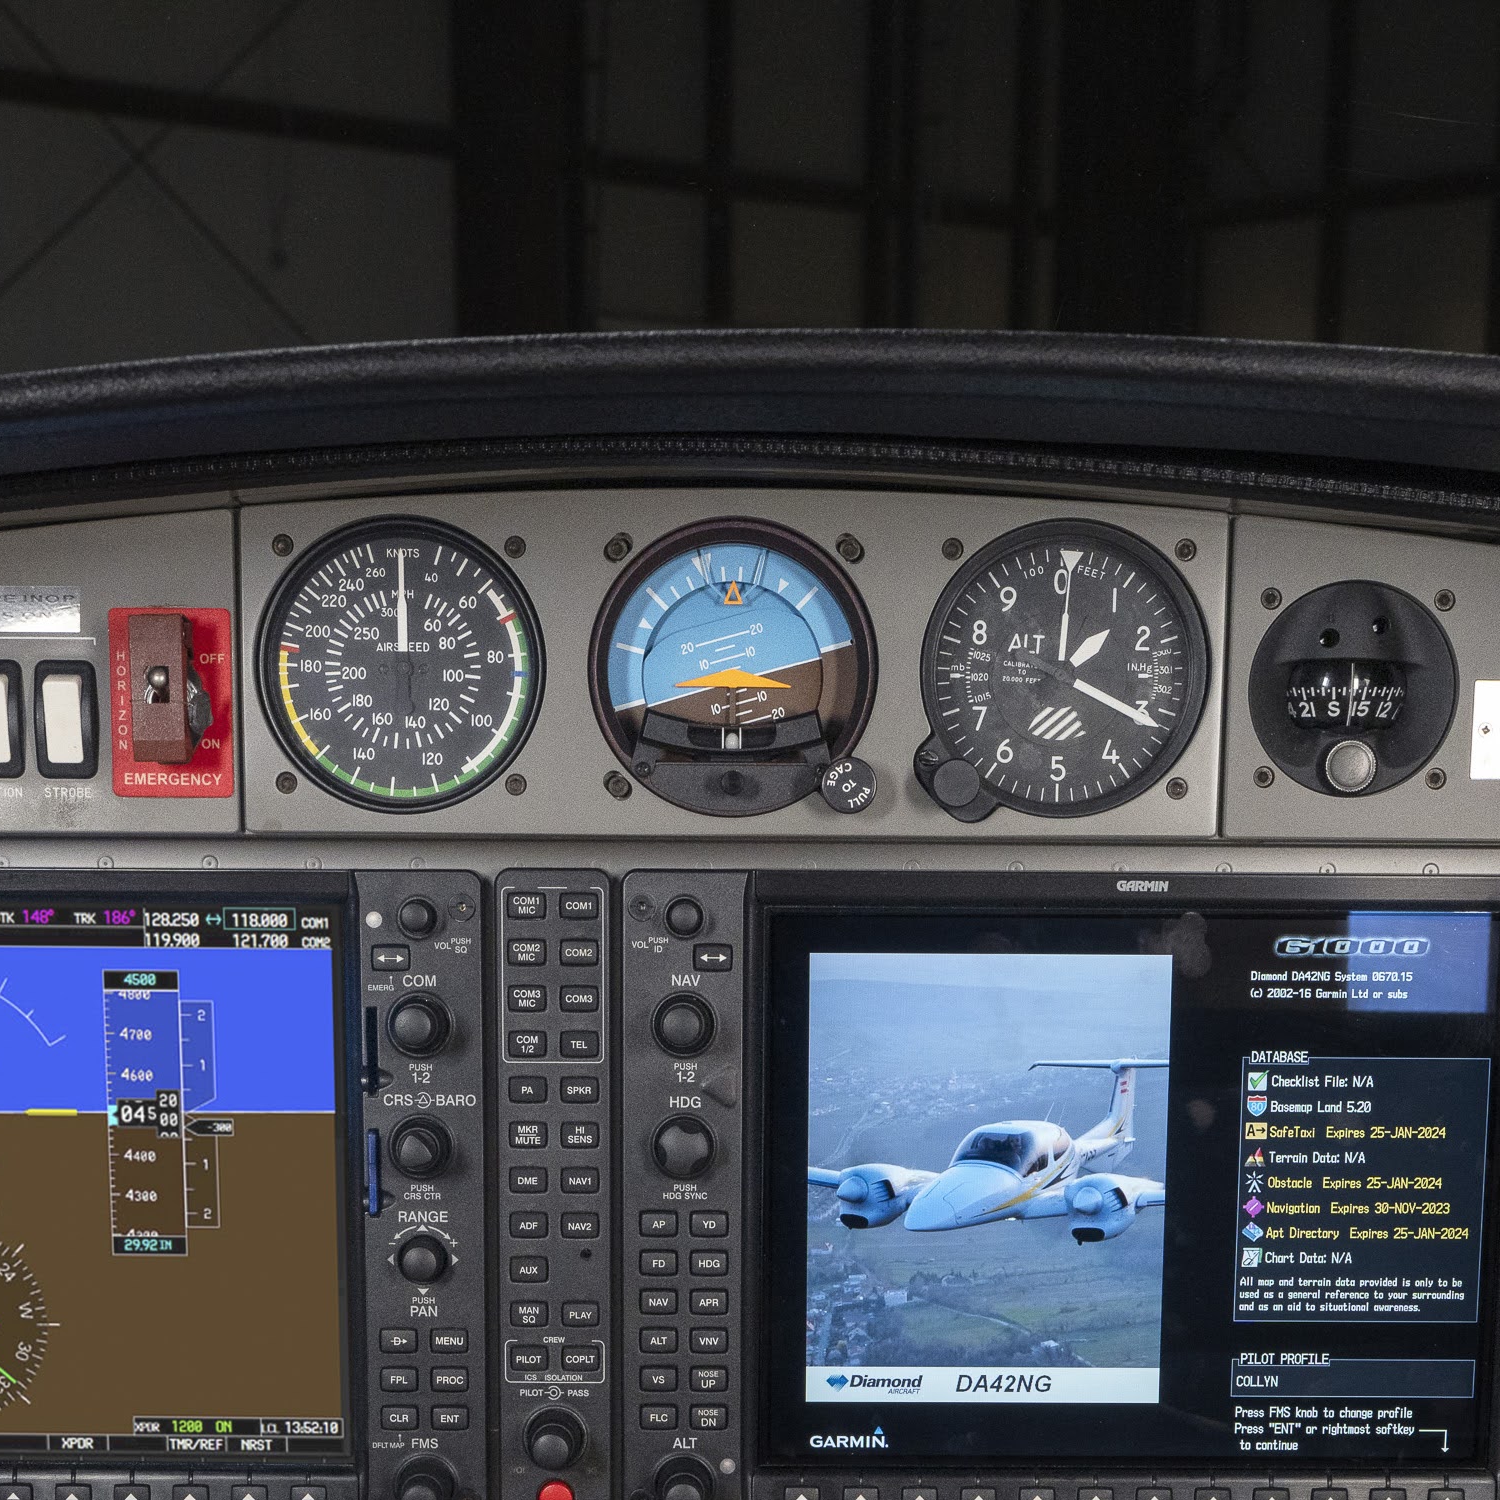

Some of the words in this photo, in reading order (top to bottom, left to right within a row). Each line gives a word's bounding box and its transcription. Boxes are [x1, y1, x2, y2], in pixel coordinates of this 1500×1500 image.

[1078, 566, 1105, 580] FEET
[339, 579, 364, 591] 240
[322, 596, 346, 607] 220
[488, 651, 503, 663] 80
[970, 673, 988, 681] 1020
[310, 709, 331, 720] 160
[1327, 701, 1340, 716] S
[827, 763, 852, 786] CAGE
[1051, 756, 1066, 781] 5
[124, 773, 222, 786] EMERGENCY
[842, 780, 856, 792] TO
[45, 787, 92, 798] STROBE
[849, 787, 870, 808] PULL
[1117, 880, 1169, 892] GARMIN
[565, 902, 592, 910] COM1
[144, 913, 199, 927] 128.250
[232, 913, 288, 927] 118.000
[301, 917, 329, 929] COM1
[123, 974, 156, 985] 4500
[402, 975, 436, 987] COM
[1251, 971, 1287, 981] Diamond
[1292, 972, 1330, 981] DA42NG
[1335, 972, 1367, 982] System
[1372, 972, 1413, 982] 0670.15
[1251, 1051, 1309, 1063] DATABASE
[567, 1086, 591, 1095] SPKR
[1270, 1127, 1315, 1138] SafeTaxi
[1326, 1127, 1365, 1140] Expires
[1370, 1127, 1446, 1139] 25-JAN-2024
[515, 1136, 540, 1145] MUTE
[398, 1211, 448, 1223] RANGE
[699, 1298, 719, 1307] APR
[435, 1337, 463, 1346] MENU
[565, 1356, 595, 1364] COPLT
[1240, 1354, 1275, 1364] PILOT
[1280, 1354, 1329, 1364] PROFILE
[436, 1376, 463, 1385] PROC
[850, 1374, 923, 1388] Diamond
[956, 1375, 1052, 1393] DA42NG
[1236, 1376, 1278, 1387] COLLYN
[1235, 1407, 1264, 1418] Press
[1269, 1407, 1290, 1418] FMS
[1296, 1407, 1318, 1418] knob
[1323, 1409, 1335, 1418] to
[1339, 1407, 1372, 1419] change
[1378, 1407, 1412, 1420] profile
[285, 1422, 338, 1434] 13:52:10
[62, 1438, 93, 1448] XPDR
[169, 1438, 222, 1450] TMR/REF
